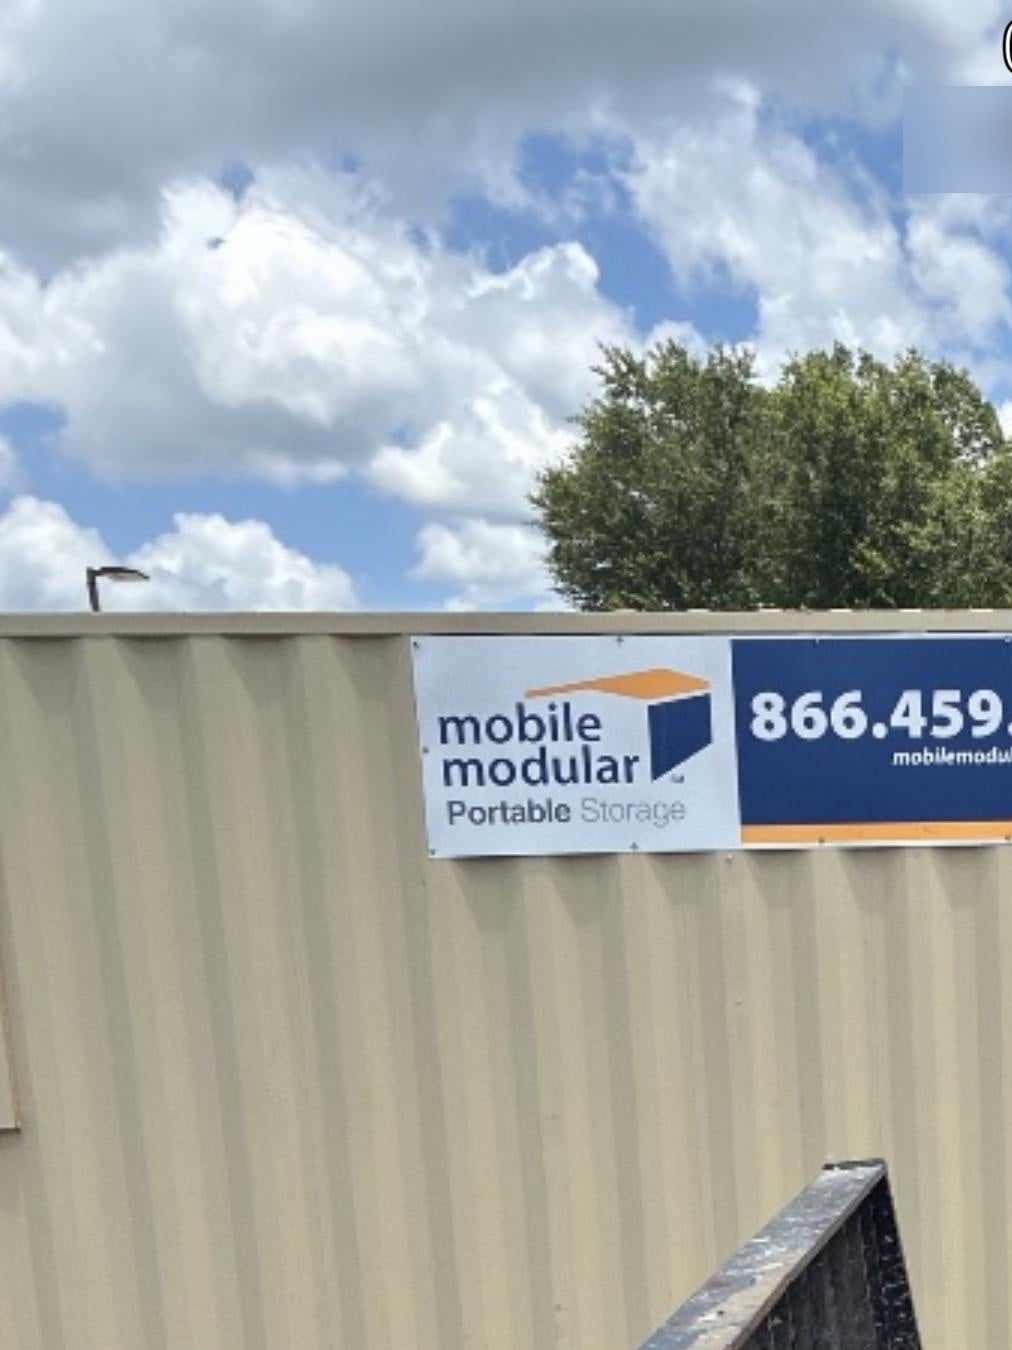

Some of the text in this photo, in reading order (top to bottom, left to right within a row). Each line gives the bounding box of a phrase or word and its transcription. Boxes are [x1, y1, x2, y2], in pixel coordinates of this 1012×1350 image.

[438, 703, 602, 745] mobile
[441, 744, 640, 787] modular
[447, 796, 687, 829] Portable Storage
